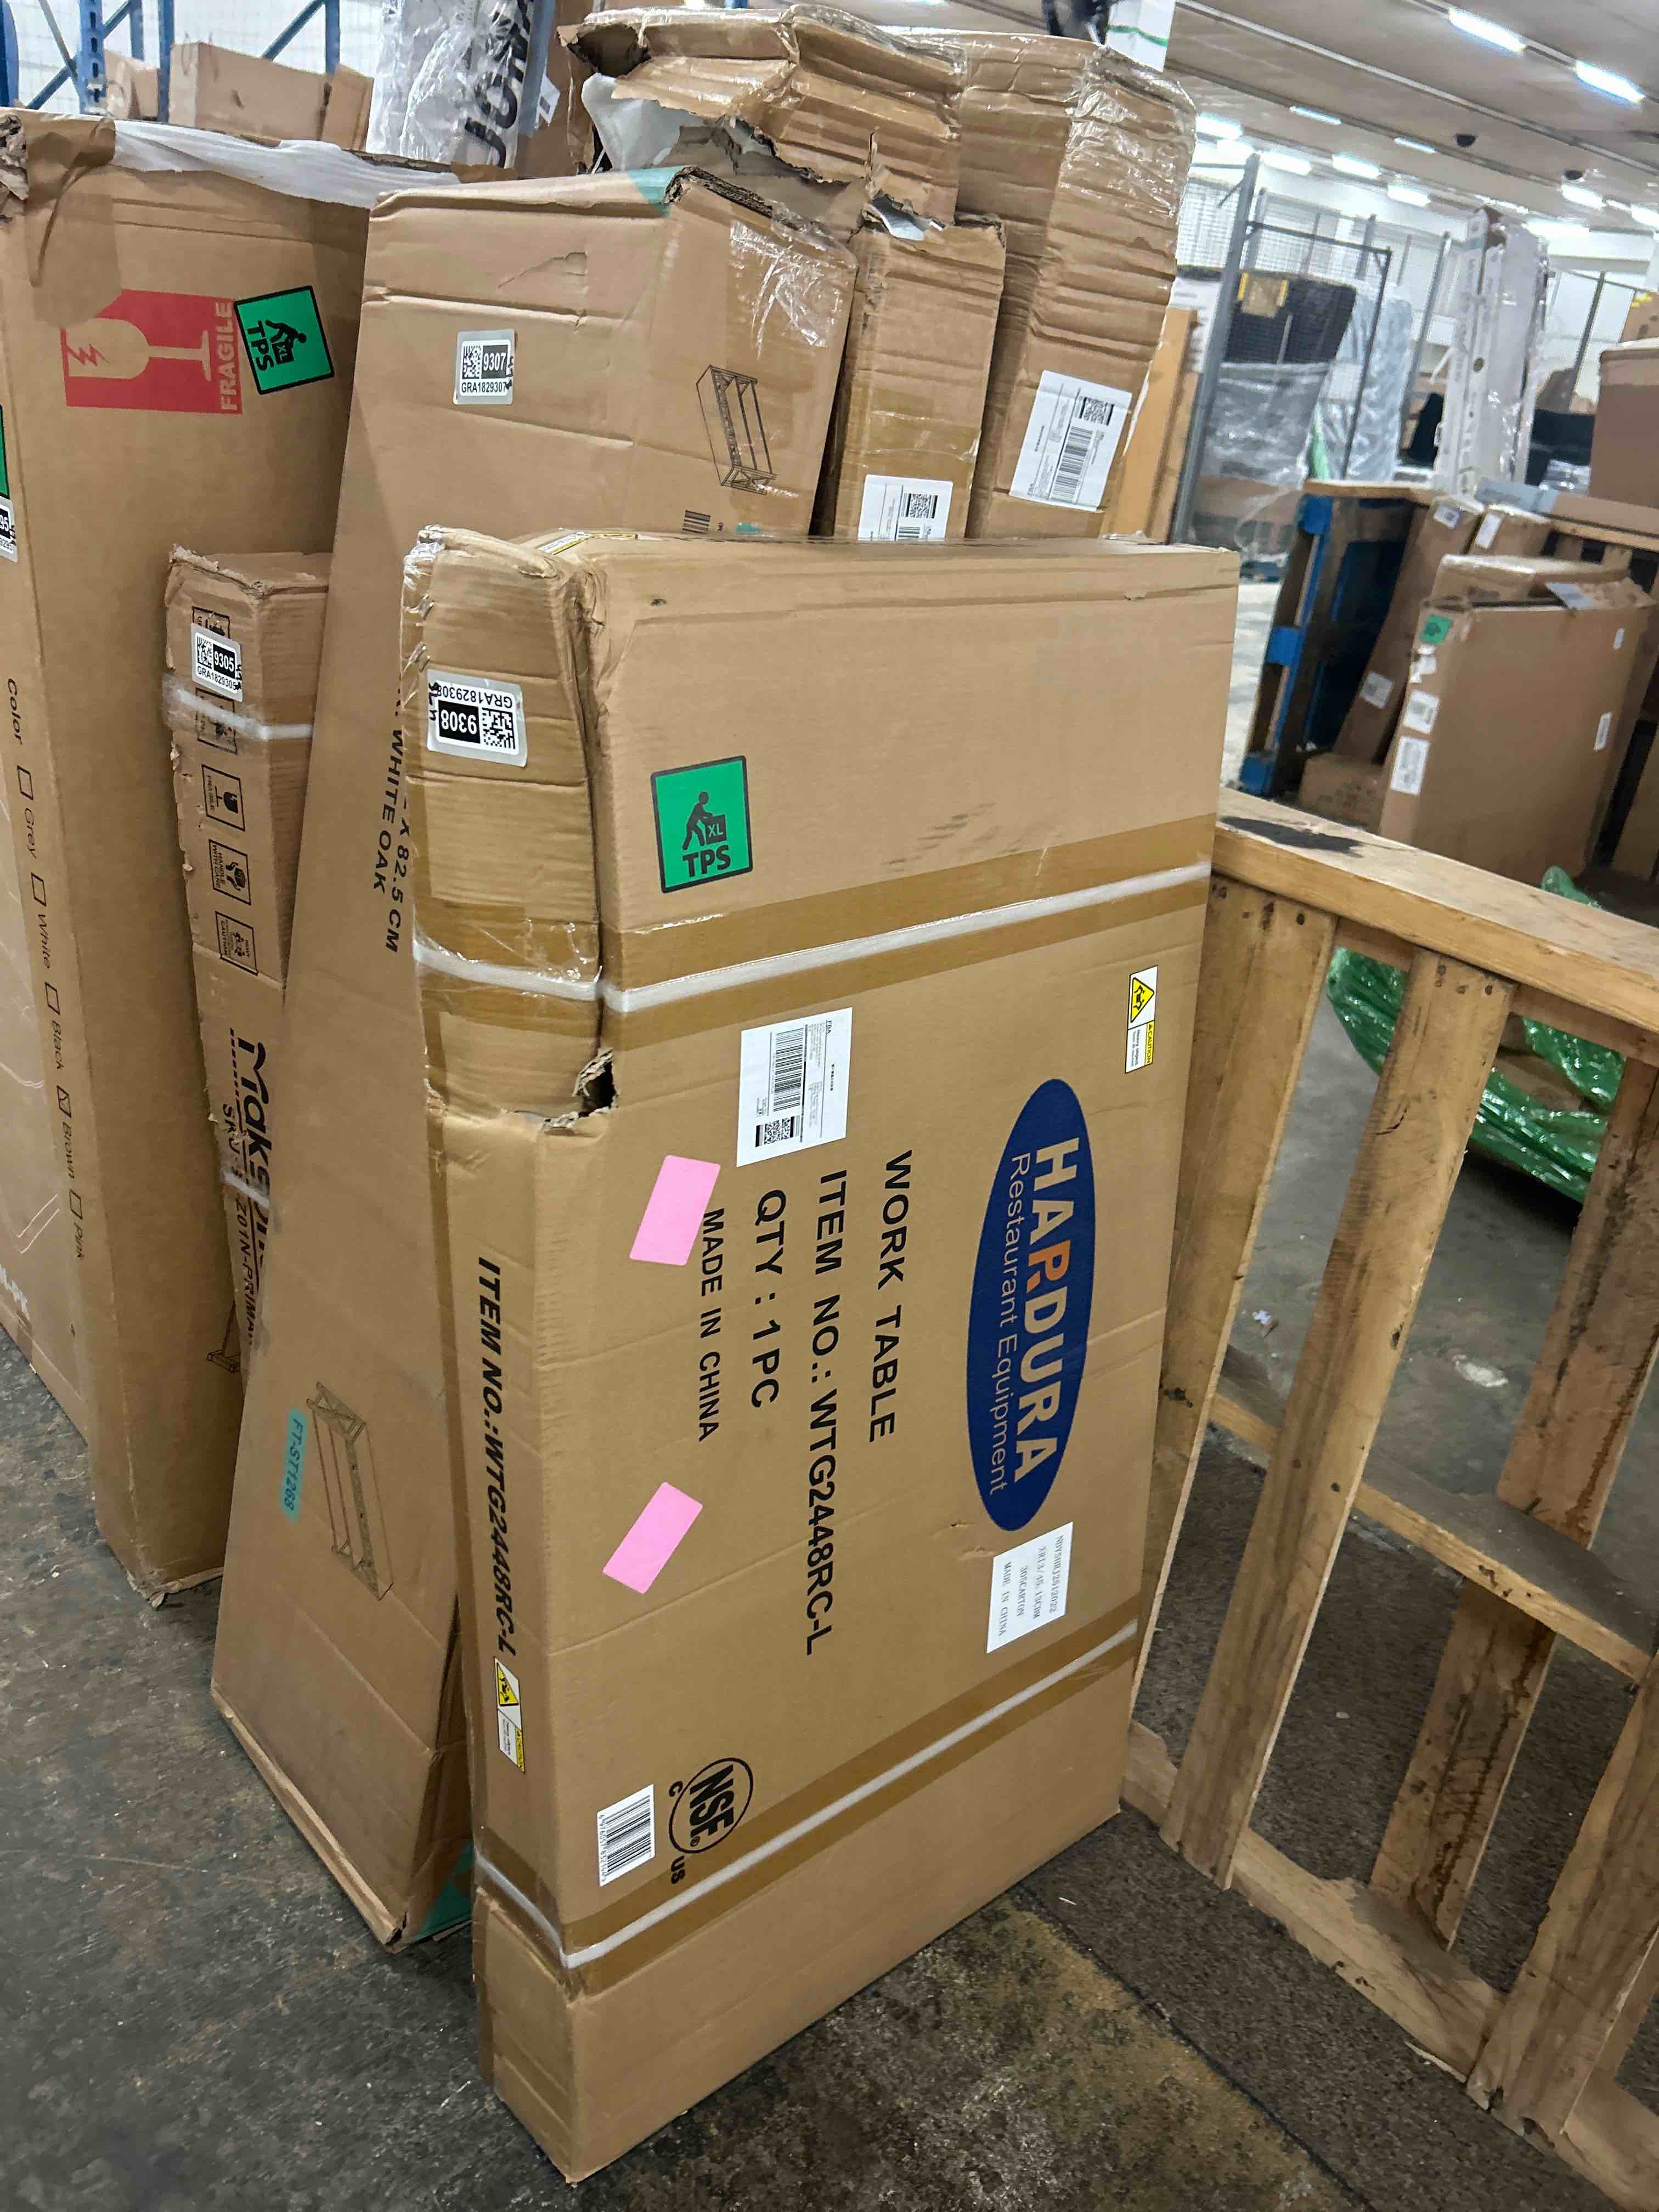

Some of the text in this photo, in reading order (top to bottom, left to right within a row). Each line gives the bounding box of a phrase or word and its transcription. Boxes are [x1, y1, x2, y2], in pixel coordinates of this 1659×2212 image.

[216, 301, 238, 411] FRAGILE
[248, 320, 274, 371] TPS
[483, 352, 506, 371] 9307
[214, 651, 235, 673] 9305
[441, 709, 477, 735] 9308
[373, 730, 403, 894] WHITE OAK
[708, 822, 724, 838] XL
[391, 845, 409, 904] 82.5
[682, 844, 731, 878] TPS
[8, 679, 86, 1260] Color Grey White Black Brown Pink
[386, 908, 402, 953] CM
[754, 1188, 787, 1275] QTY
[815, 1169, 848, 1276] ITEM
[478, 1257, 501, 1356] ITEM
[698, 1208, 725, 1442] MADE IN CHINA
[870, 1149, 913, 1443] WORK TABLE
[989, 1152, 1031, 1497] Restaurant Equipment
[1014, 1137, 1080, 1483] HARDURA
[998, 1562, 1012, 1637] MADE IN CHINA
[670, 1855, 686, 1884] US
